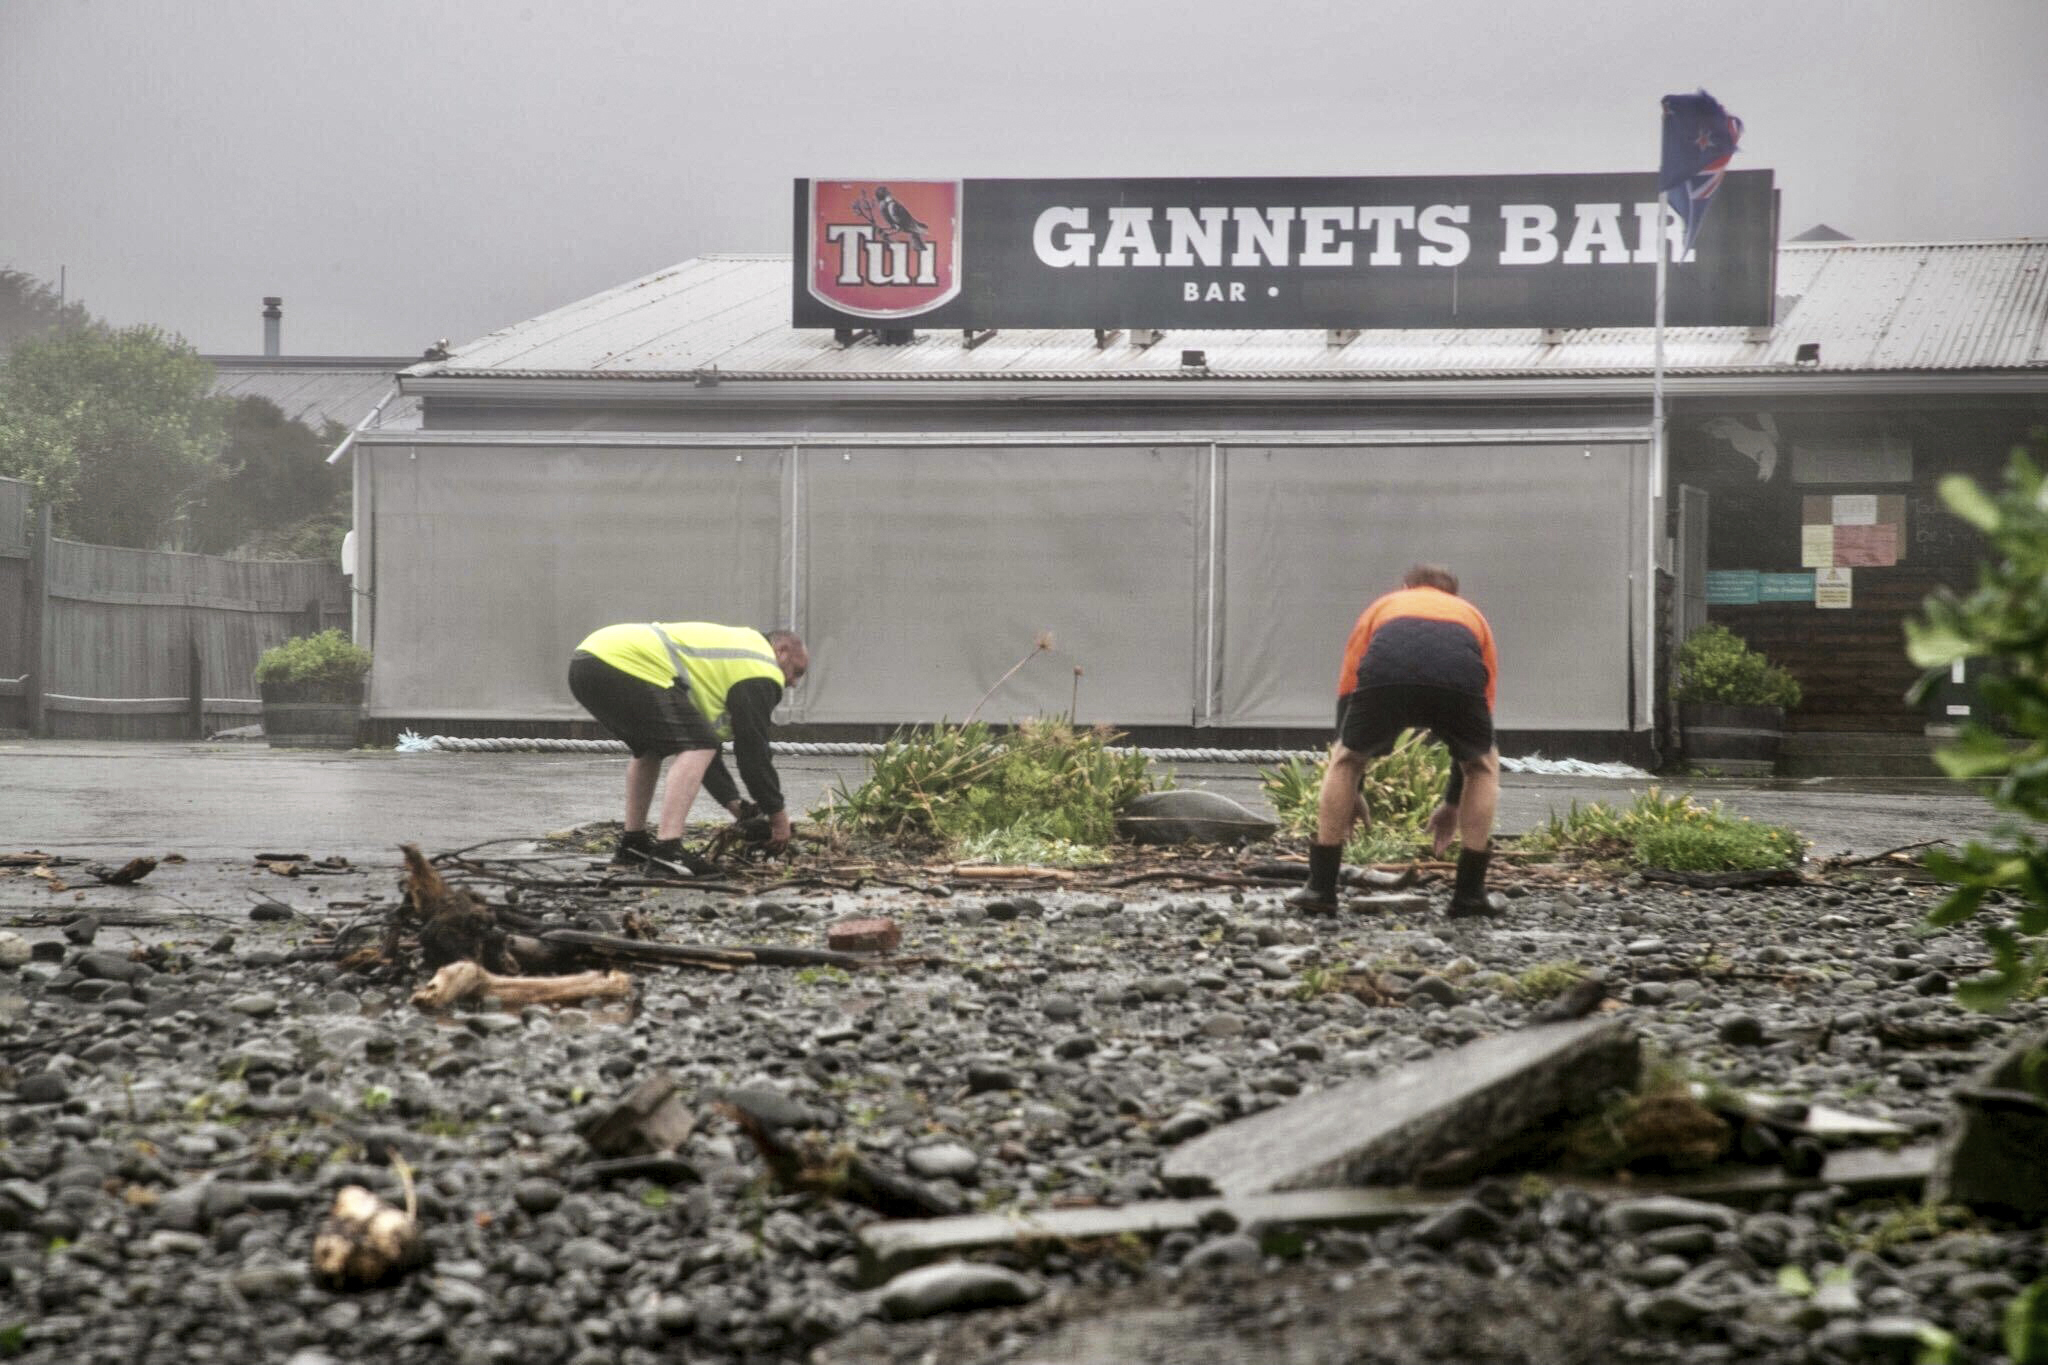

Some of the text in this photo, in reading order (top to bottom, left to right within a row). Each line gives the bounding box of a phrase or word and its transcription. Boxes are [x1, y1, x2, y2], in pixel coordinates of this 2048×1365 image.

[827, 225, 937, 286] Tui
[1033, 203, 1696, 267] GANNETS BAR
[1184, 282, 1247, 302] BAR
